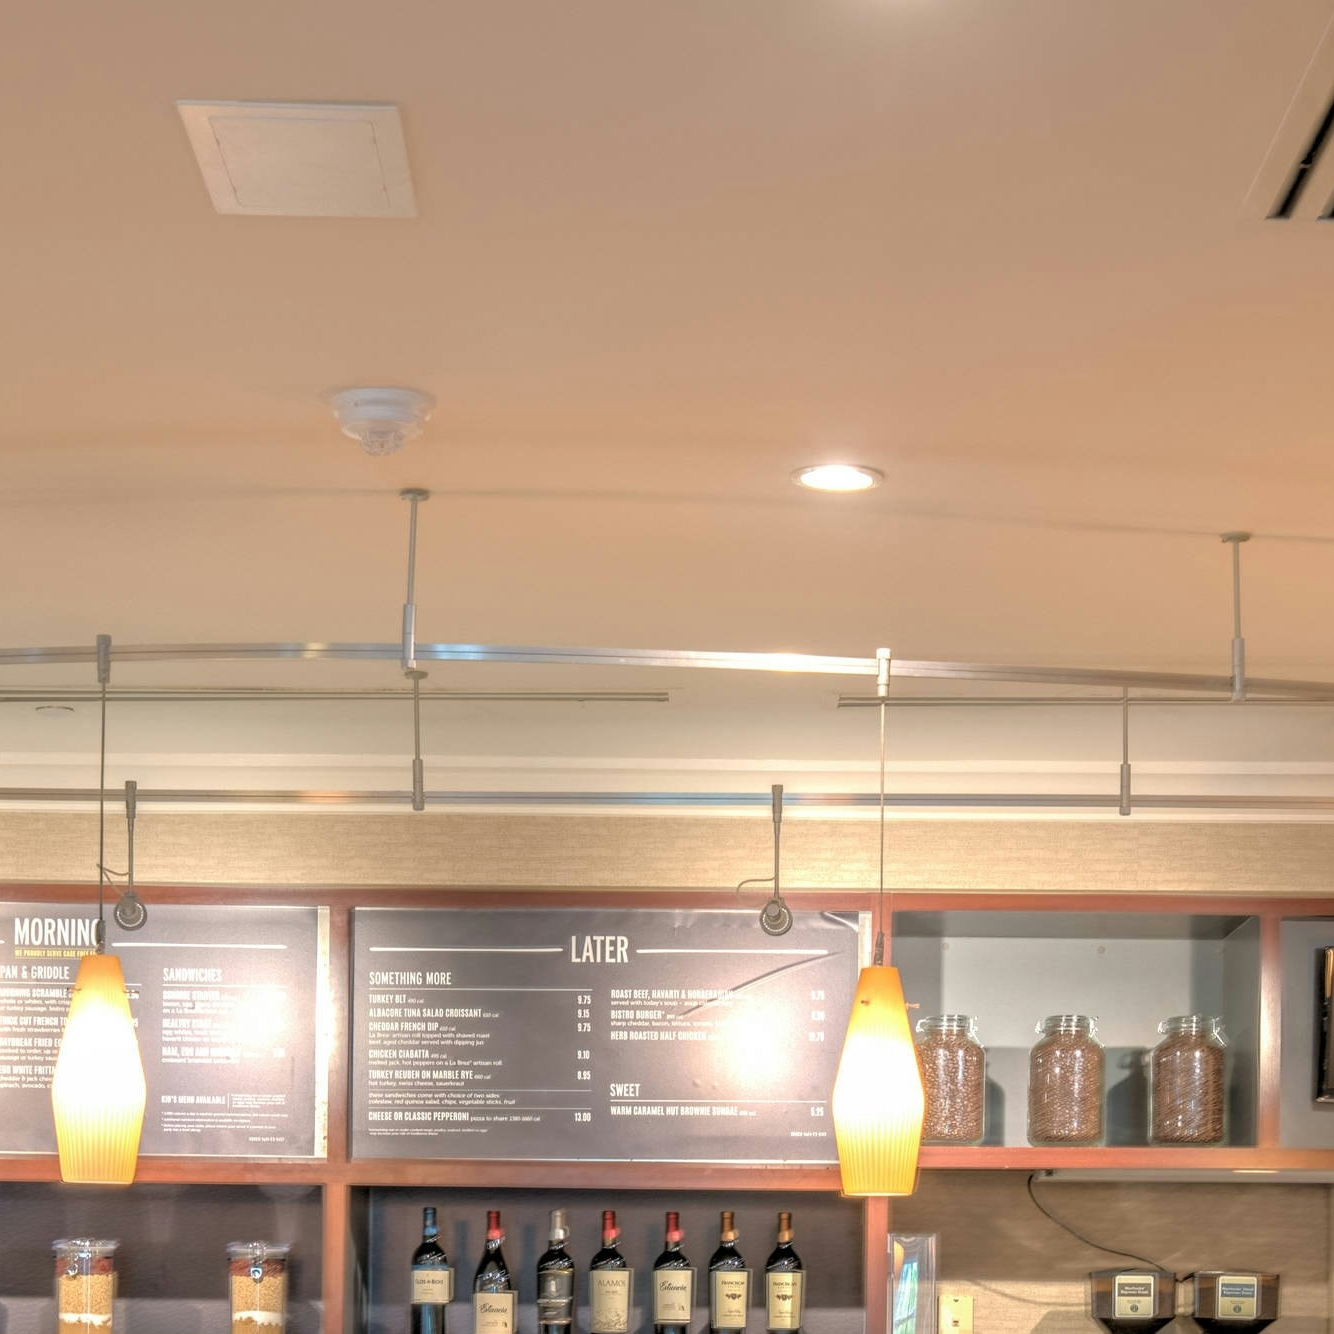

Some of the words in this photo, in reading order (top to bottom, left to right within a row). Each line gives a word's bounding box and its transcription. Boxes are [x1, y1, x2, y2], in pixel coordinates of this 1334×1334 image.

[571, 936, 628, 962] LATER
[0, 966, 18, 979] PAN
[22, 966, 28, 979] &
[31, 966, 70, 979] GRIDDLE
[163, 968, 222, 982] SANDWICHES
[369, 972, 422, 985] SOMETHING
[426, 972, 452, 985] MORE
[369, 994, 393, 1004] TURKEY
[395, 995, 406, 1004] BLT
[611, 989, 632, 998] ROAST
[634, 990, 650, 1000] BEEF,
[652, 990, 679, 998] HAVARTI
[681, 990, 685, 998] &
[578, 995, 591, 1005] 9.75
[369, 1008, 402, 1017] ALBACORE
[404, 1008, 421, 1017] TUNA
[423, 1009, 444, 1017] SALAD
[446, 1009, 481, 1018] CROISSANT
[577, 1009, 589, 1018] 9.15
[611, 1010, 634, 1019] BISTRO
[369, 1022, 399, 1031] CHEDDAR
[401, 1022, 426, 1031] FRENCH
[428, 1023, 438, 1031] DIP
[577, 1023, 591, 1032] 9.75
[611, 1031, 628, 1040] HERB
[630, 1031, 658, 1040] ROASTED
[660, 1032, 676, 1040] HALF
[369, 1050, 397, 1058] CHICKEN
[399, 1050, 429, 1058] CIABATTA
[369, 1070, 393, 1079] TURKEY
[395, 1070, 419, 1079] REUBEN
[422, 1071, 430, 1079] ON
[433, 1071, 459, 1079] MARBLE
[461, 1071, 473, 1079] RYE
[610, 1084, 640, 1096] SWEET
[611, 1106, 632, 1115] WARM
[634, 1106, 664, 1115] CARAMEL
[666, 1106, 678, 1115] NUT
[681, 1106, 710, 1115] BROWNIE
[369, 1112, 392, 1120] CHEESE
[394, 1112, 402, 1120] OR
[404, 1112, 431, 1120] CLASSIC
[433, 1112, 469, 1121] PEPPERONI
